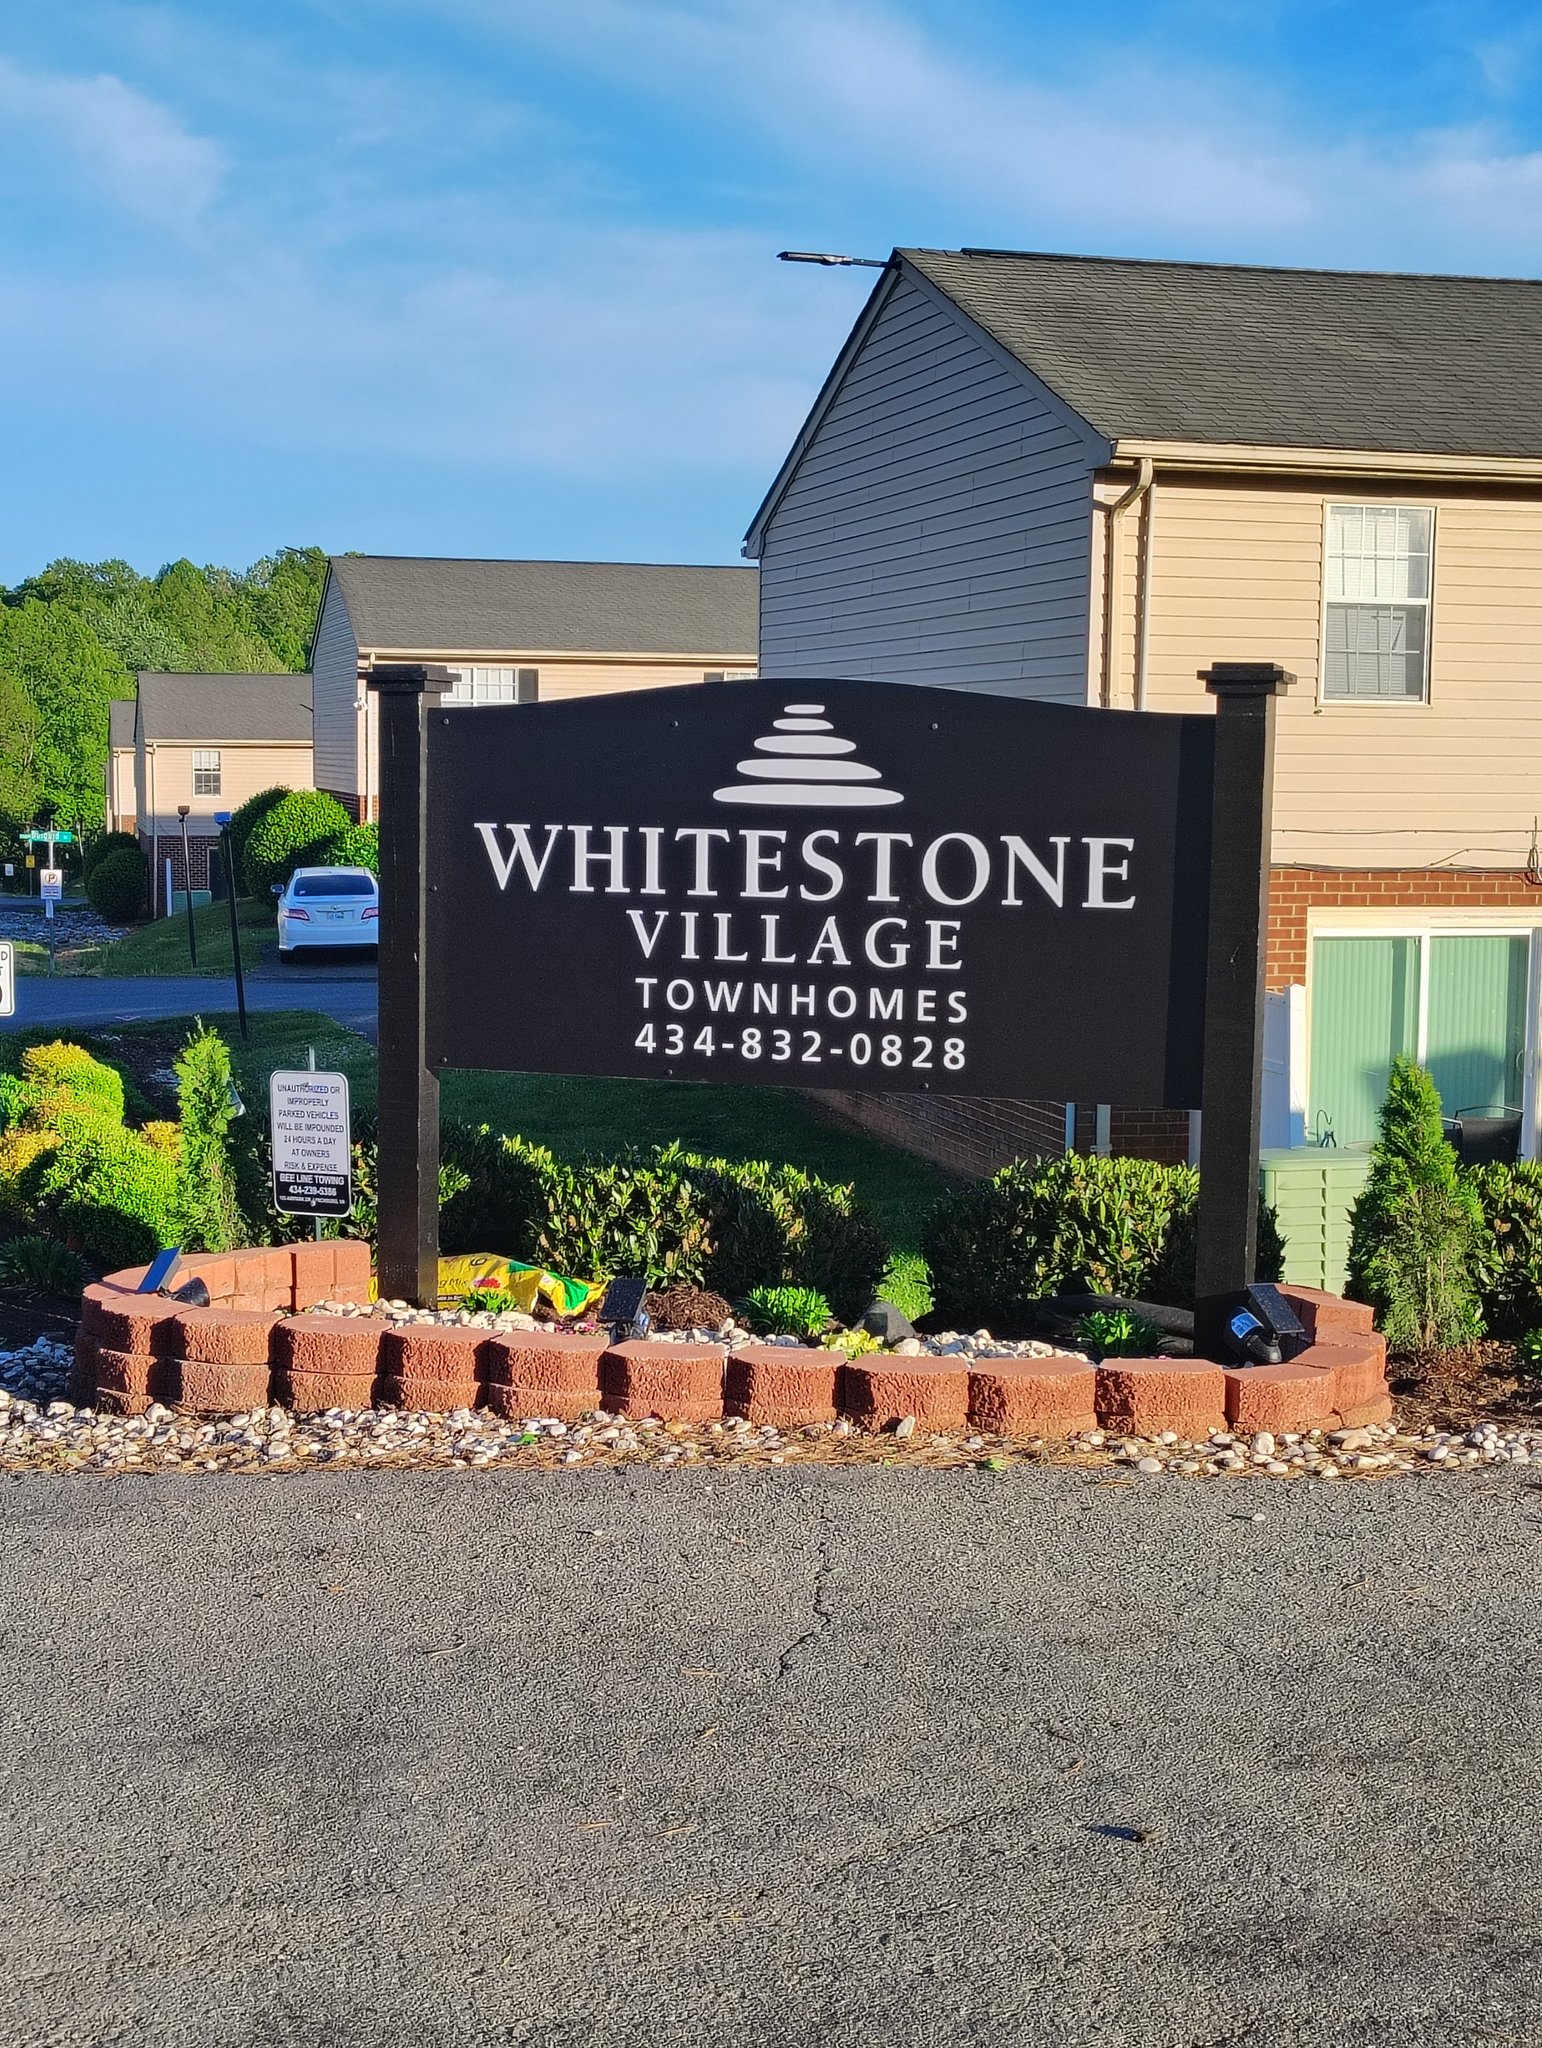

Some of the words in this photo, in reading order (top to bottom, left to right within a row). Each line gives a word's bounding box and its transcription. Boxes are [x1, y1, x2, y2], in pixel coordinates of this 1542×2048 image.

[474, 823, 1135, 908] WHITESTONE
[626, 910, 962, 969] VILLAGE
[635, 978, 967, 1023] TOWNHOMES
[635, 1024, 965, 1069] 434-832-0828
[278, 1084, 328, 1093] UNAUTHORIZED
[330, 1086, 340, 1094] OR
[288, 1097, 329, 1106] IMPROPERLY
[279, 1110, 305, 1118] PARKED
[306, 1111, 339, 1119] VEHICLES
[277, 1122, 292, 1130] WILL
[305, 1124, 344, 1132] IMPOUNDED
[284, 1135, 291, 1143] 24
[293, 1136, 316, 1144] HOURS
[323, 1137, 336, 1145] DAY
[301, 1149, 330, 1158] OWNERS
[284, 1161, 299, 1170] RISK
[301, 1162, 306, 1170] &
[307, 1163, 338, 1172] EXPENSE
[280, 1173, 295, 1182] BEE
[296, 1174, 313, 1183] LINE
[314, 1175, 344, 1185] TOWING
